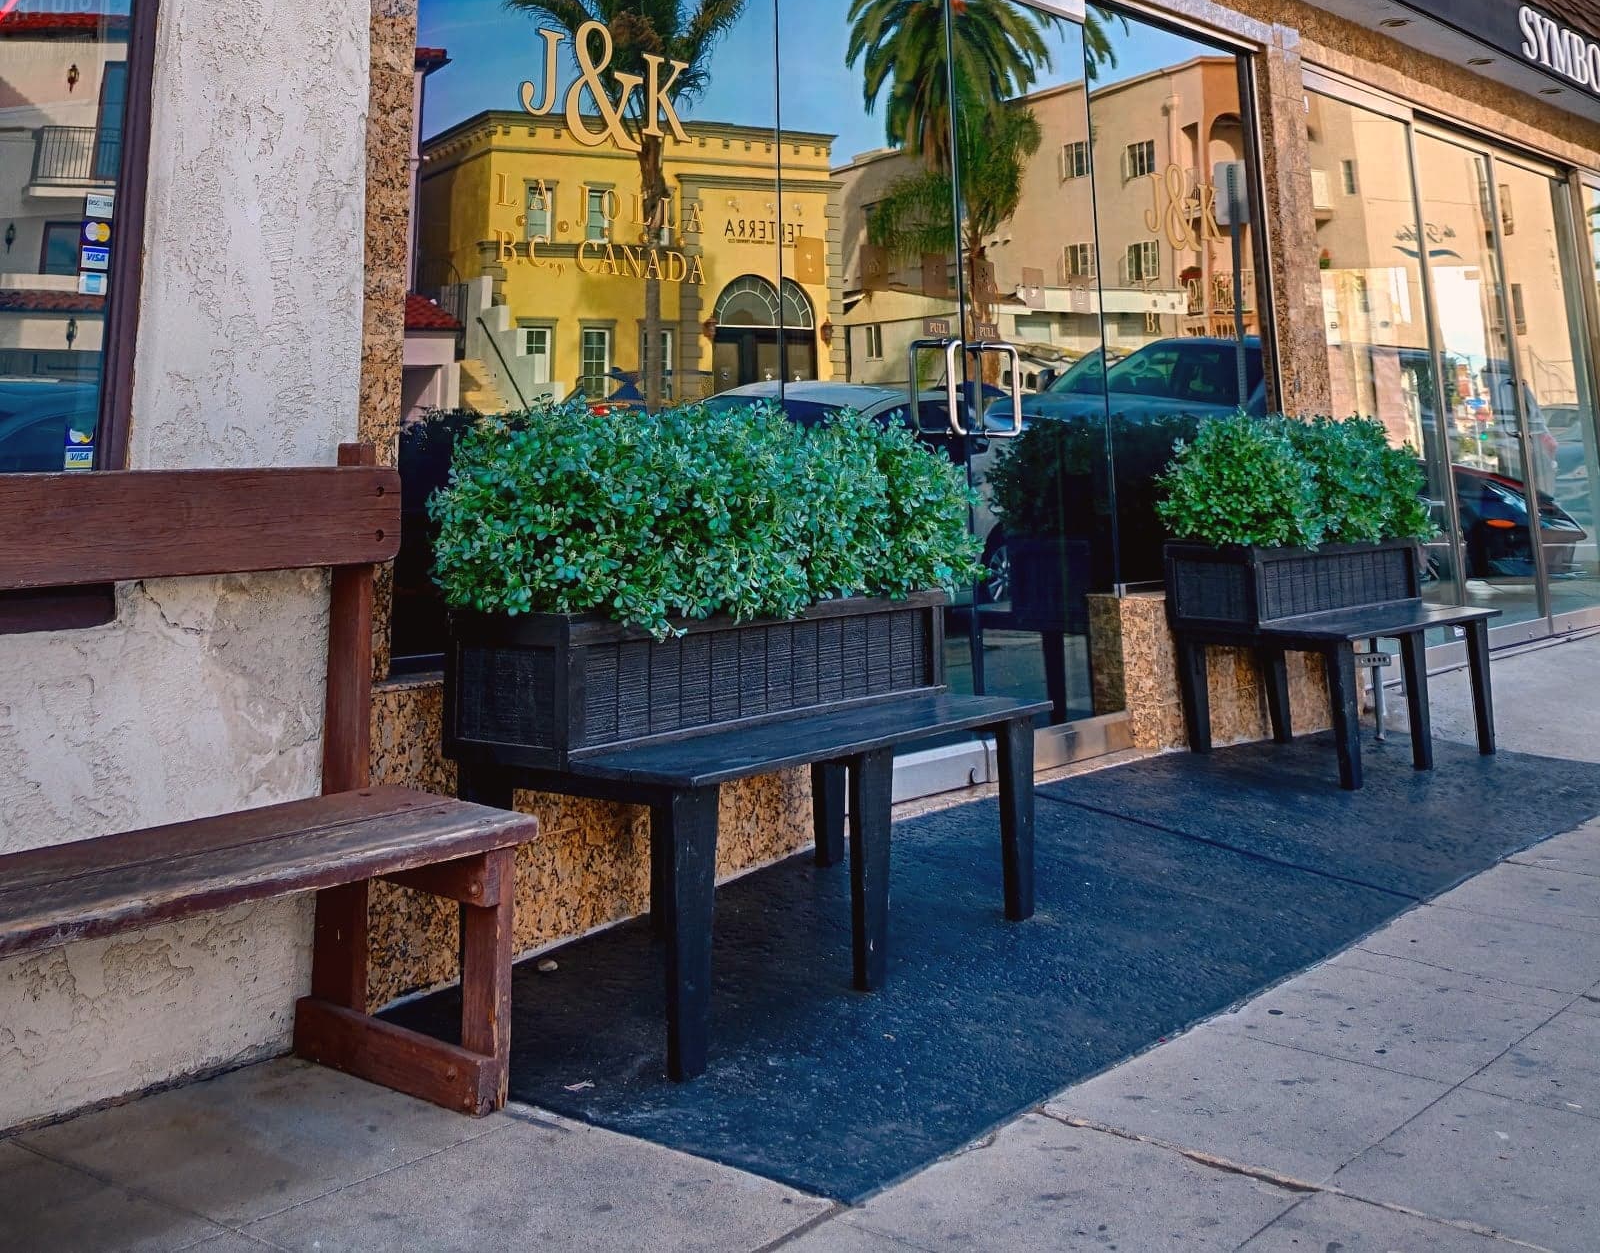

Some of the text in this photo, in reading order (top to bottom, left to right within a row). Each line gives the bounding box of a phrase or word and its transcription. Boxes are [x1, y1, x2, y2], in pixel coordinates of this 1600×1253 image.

[520, 19, 693, 152] J&K
[575, 185, 705, 234] JOLLA
[1144, 163, 1225, 252] J&K
[86, 253, 106, 262] VISA
[575, 239, 708, 286] CANADA
[929, 321, 949, 334] PULL
[978, 326, 996, 338] PULL
[70, 452, 89, 461] VISA
